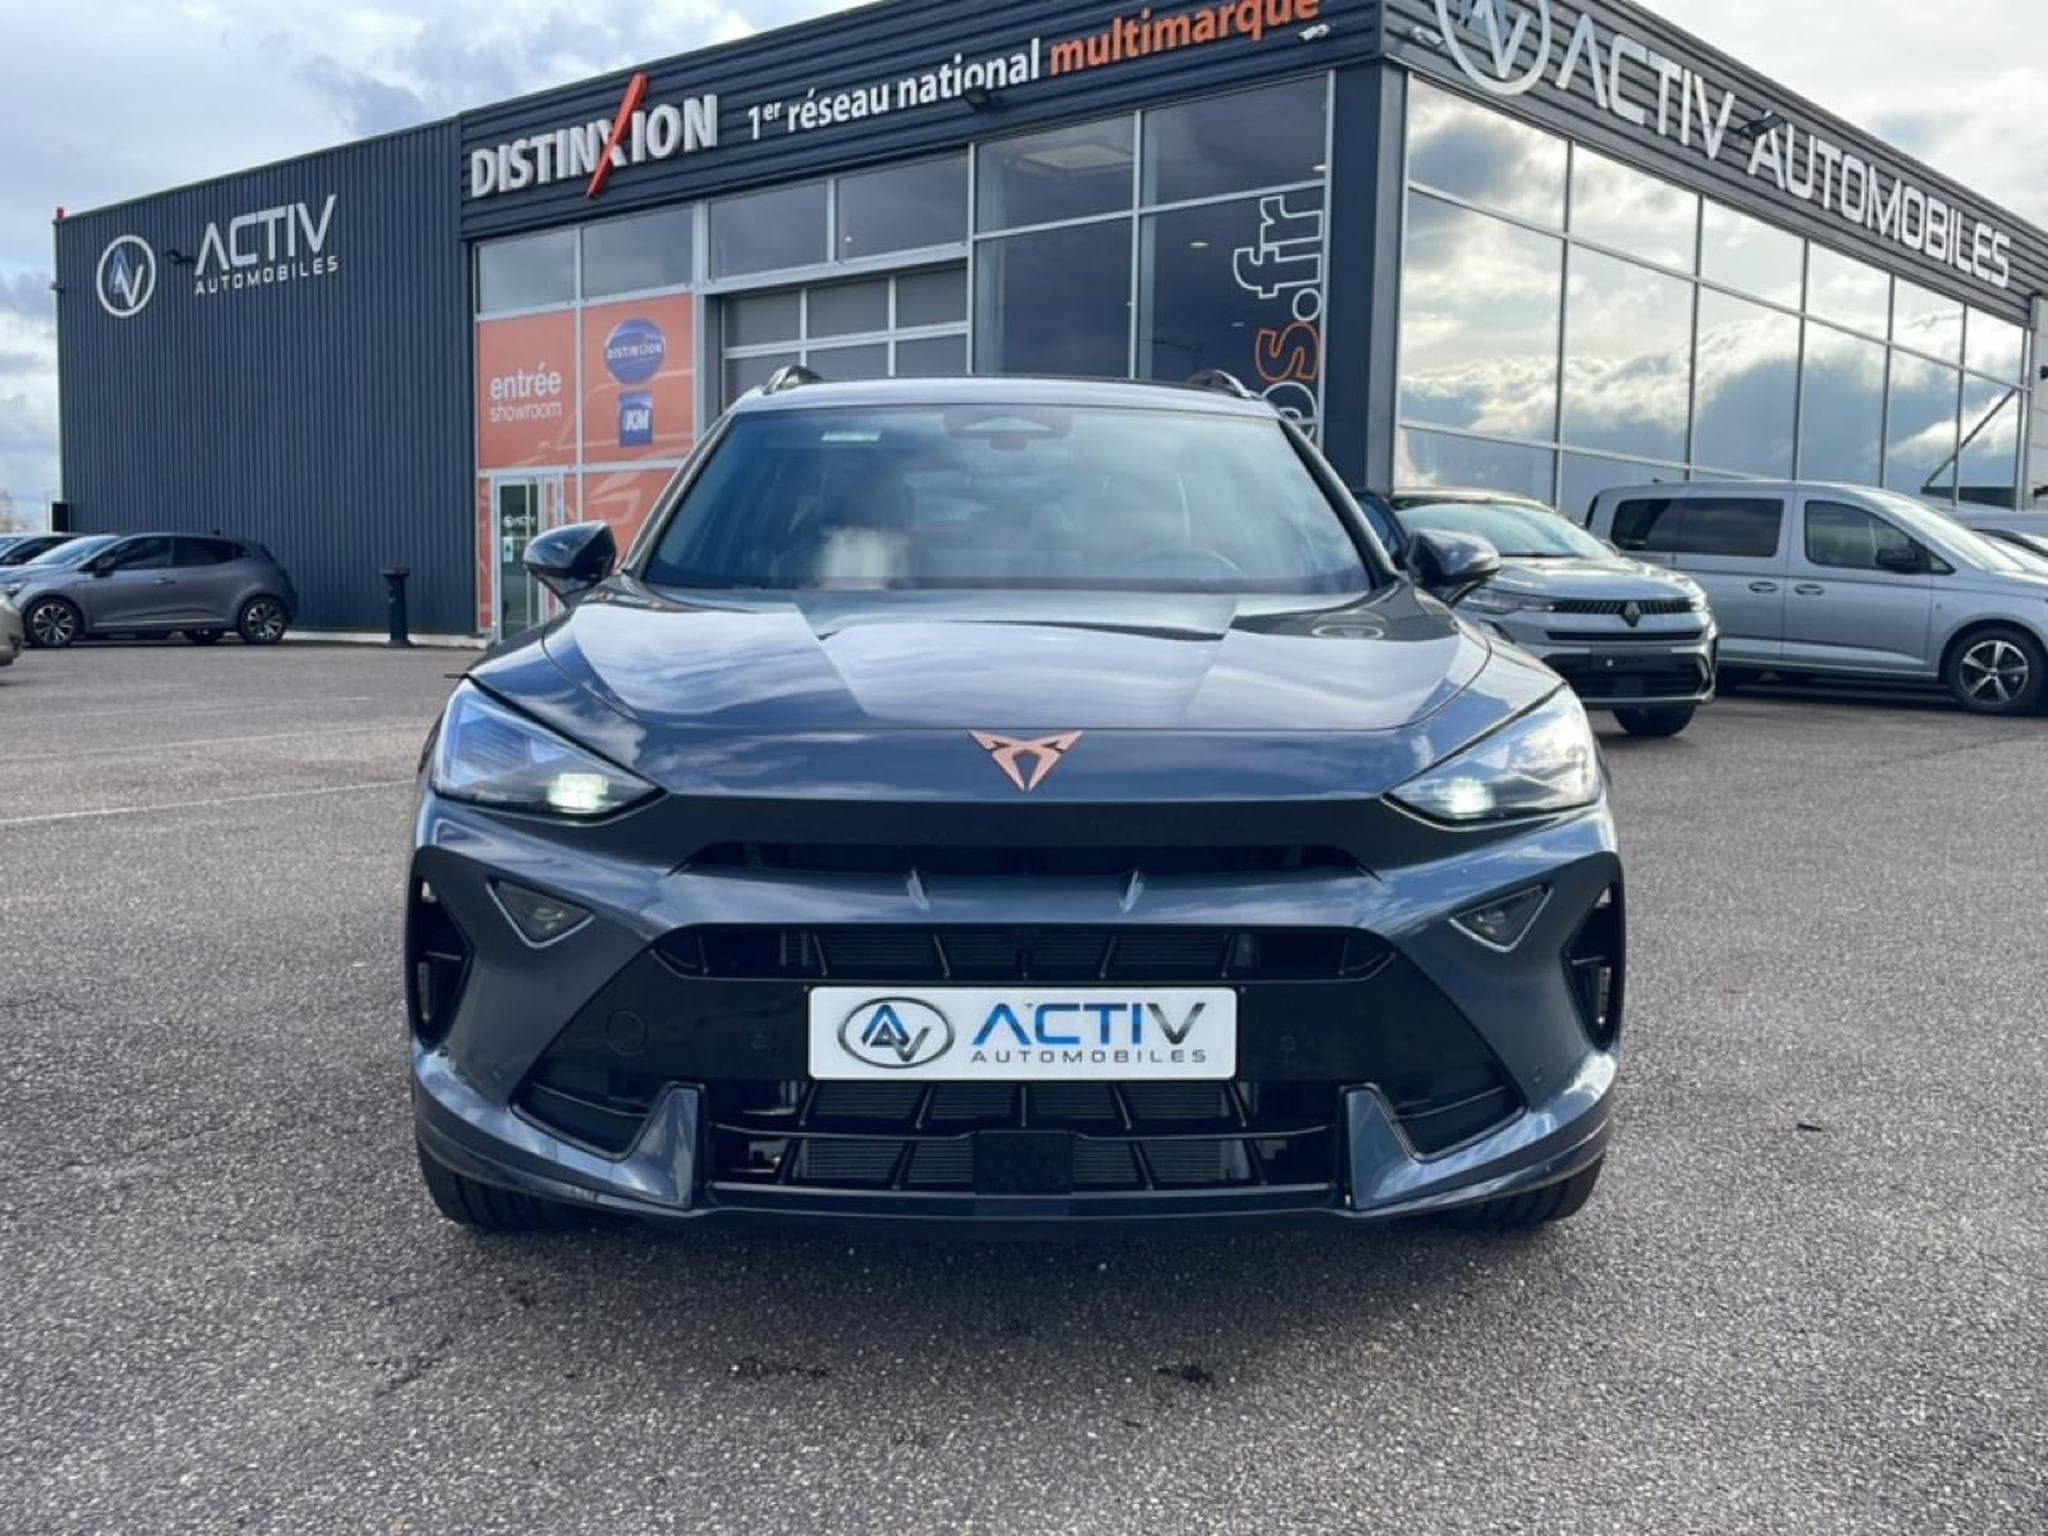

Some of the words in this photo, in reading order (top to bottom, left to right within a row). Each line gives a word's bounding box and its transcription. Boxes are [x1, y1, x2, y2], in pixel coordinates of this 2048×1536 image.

[788, 83, 889, 133] réseau
[897, 37, 1040, 109] national
[1050, 0, 1320, 76] multimarque
[1555, 13, 1736, 161] ACTIV
[471, 73, 718, 198] DISTINXION
[1747, 116, 2011, 290] AUTOMOBILES
[194, 194, 337, 276] ACTIV
[194, 255, 339, 296] AUTOMOBILES
[490, 361, 562, 400] entrée
[490, 402, 562, 423] showroom
[972, 1002, 1206, 1046] ACTIV
[970, 1049, 1206, 1064] AUTOMOBILES
